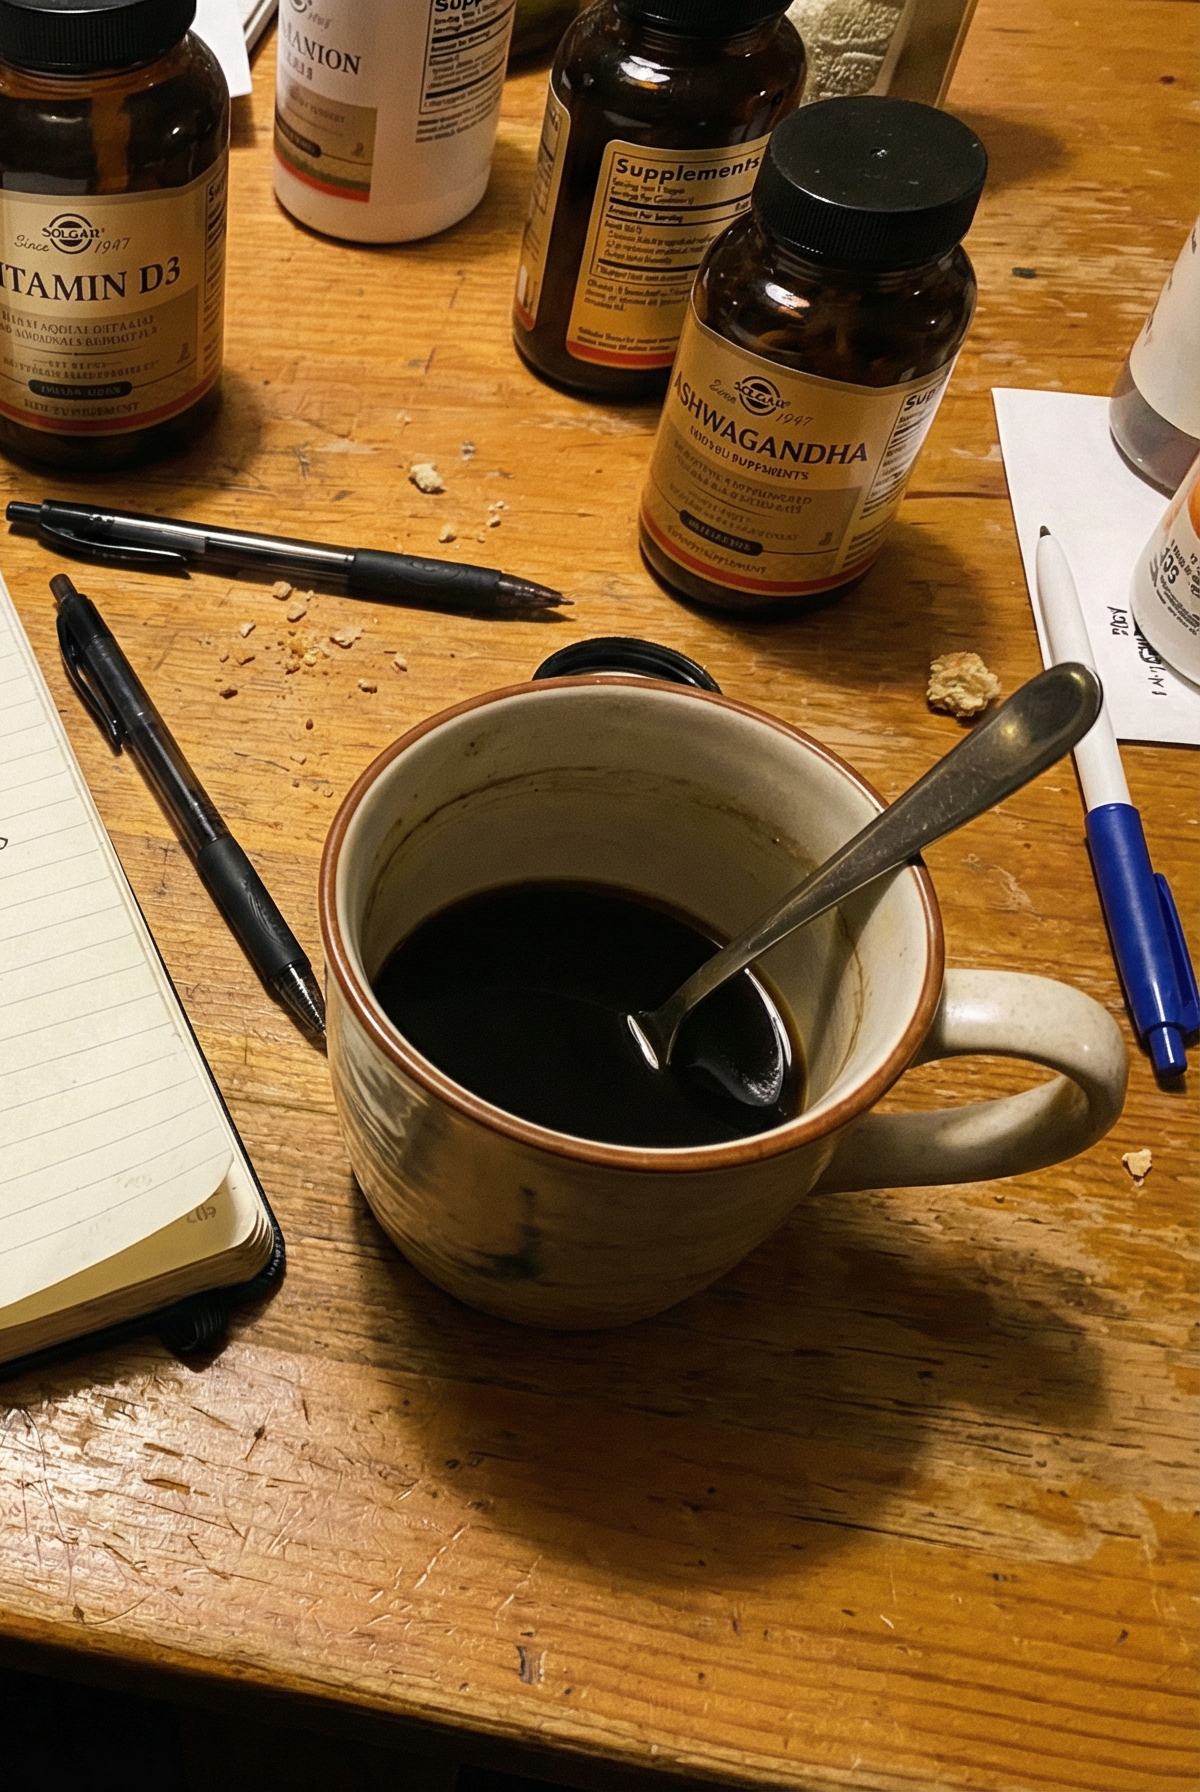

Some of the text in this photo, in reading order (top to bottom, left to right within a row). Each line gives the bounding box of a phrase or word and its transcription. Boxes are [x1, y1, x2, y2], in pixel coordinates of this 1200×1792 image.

[615, 156, 760, 184] Supplements
[139, 256, 182, 294] D3
[674, 370, 868, 466] ASHWAGANDHA
